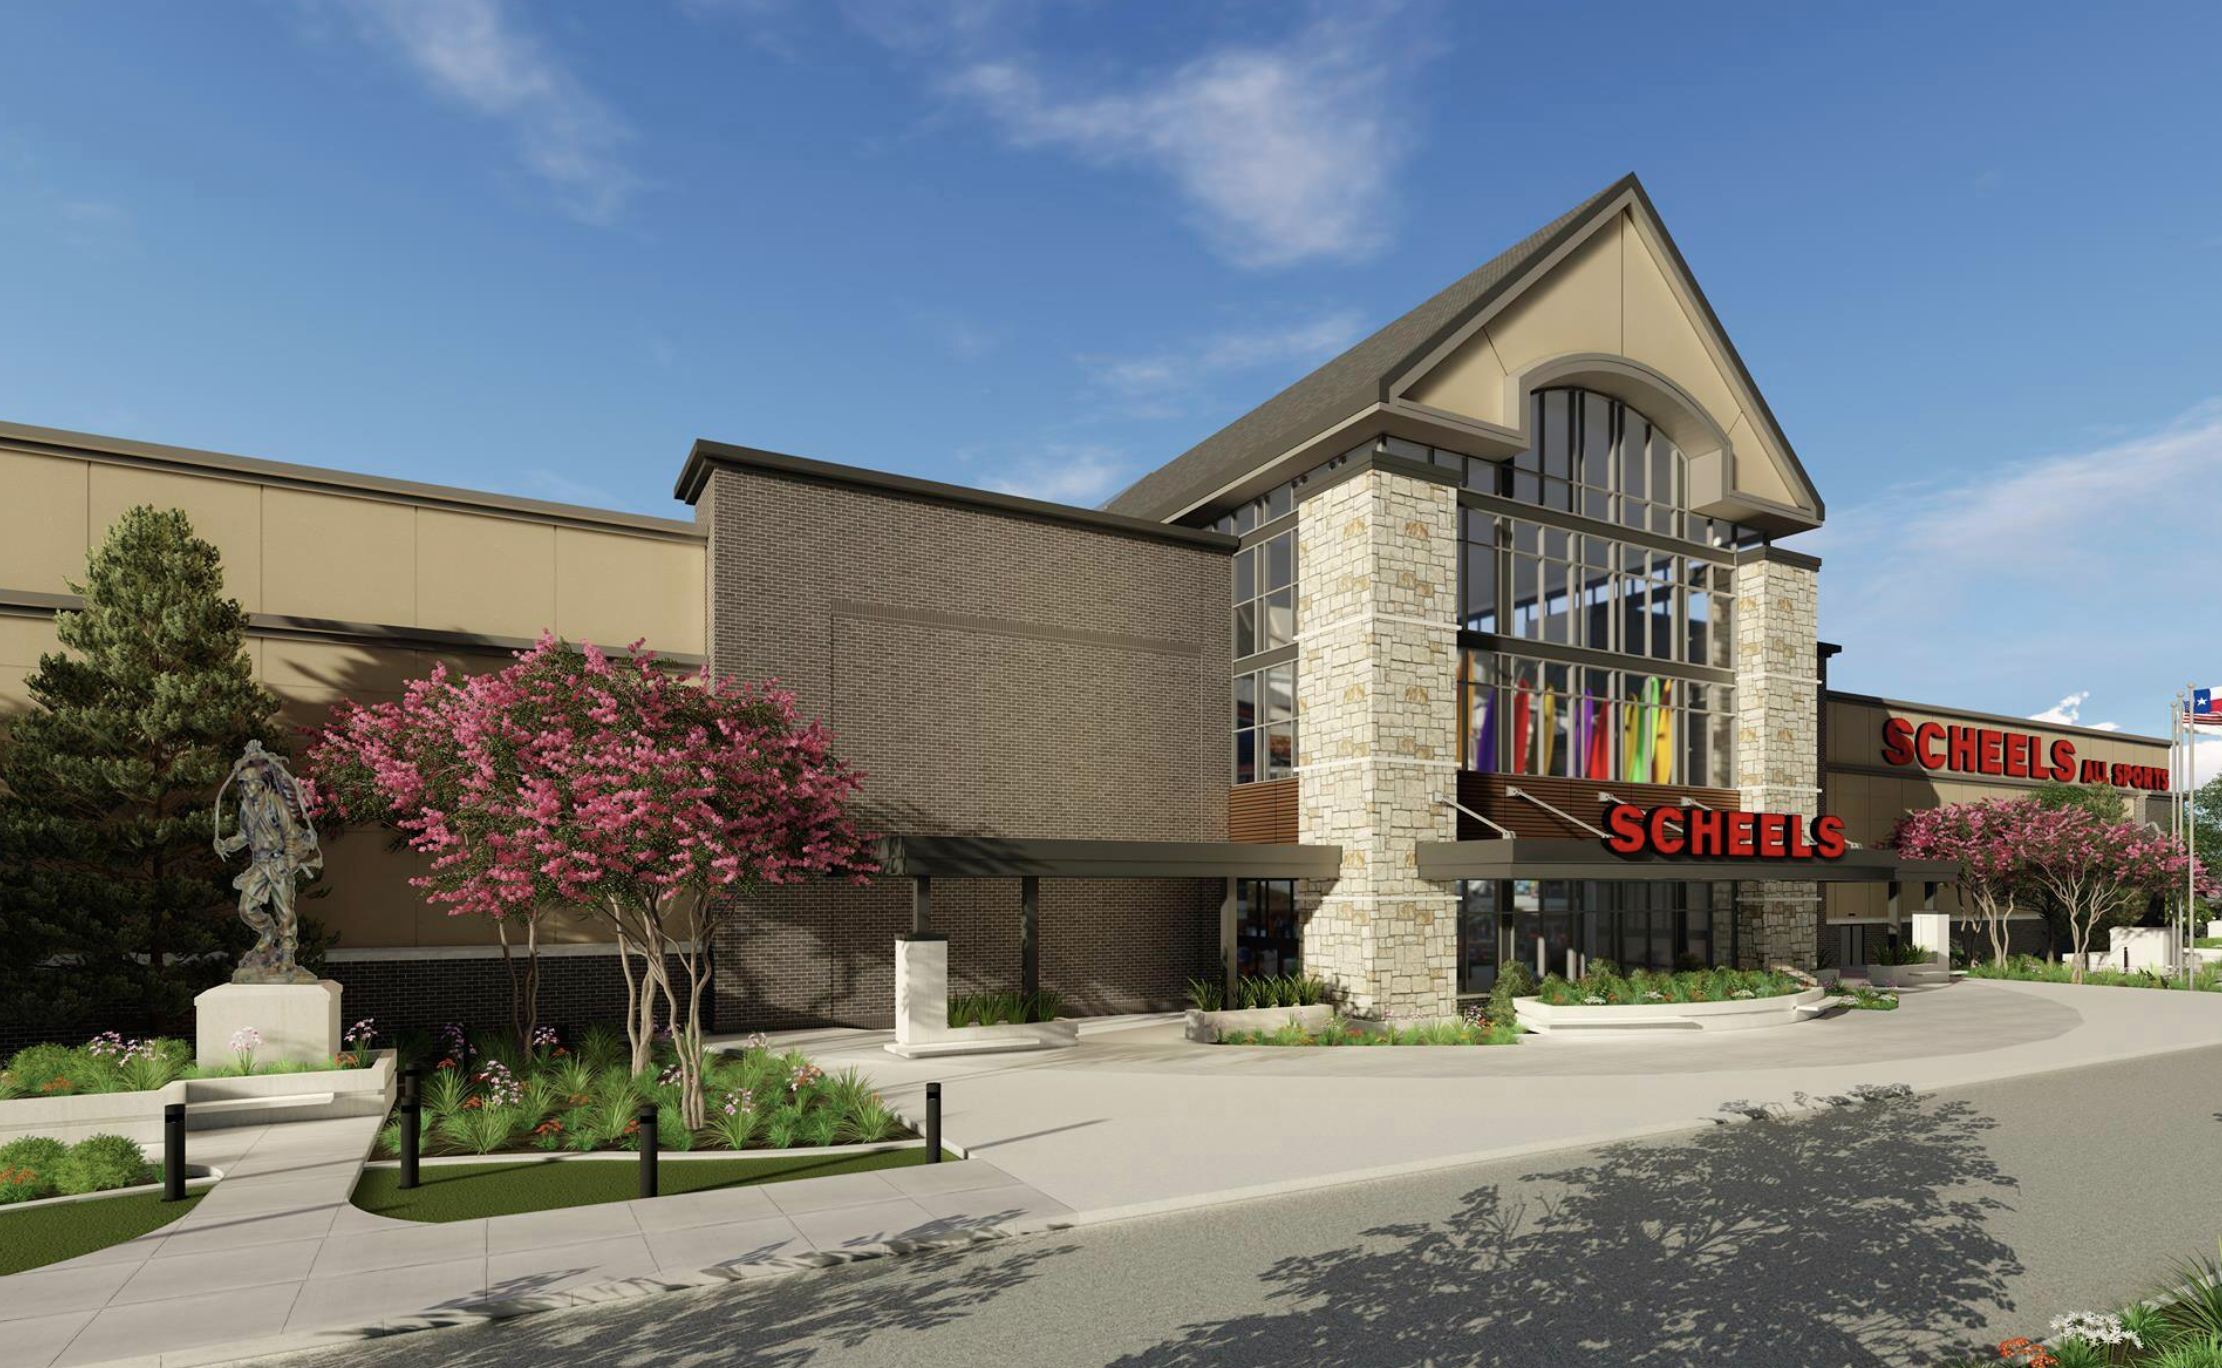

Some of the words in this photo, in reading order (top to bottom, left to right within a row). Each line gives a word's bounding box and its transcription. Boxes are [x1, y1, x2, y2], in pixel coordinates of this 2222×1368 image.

[1882, 717, 2076, 783] SCHEELS
[2080, 759, 2109, 784] ALL
[2111, 763, 2169, 791] SPORTS
[1602, 803, 1845, 859] SCHEELS
